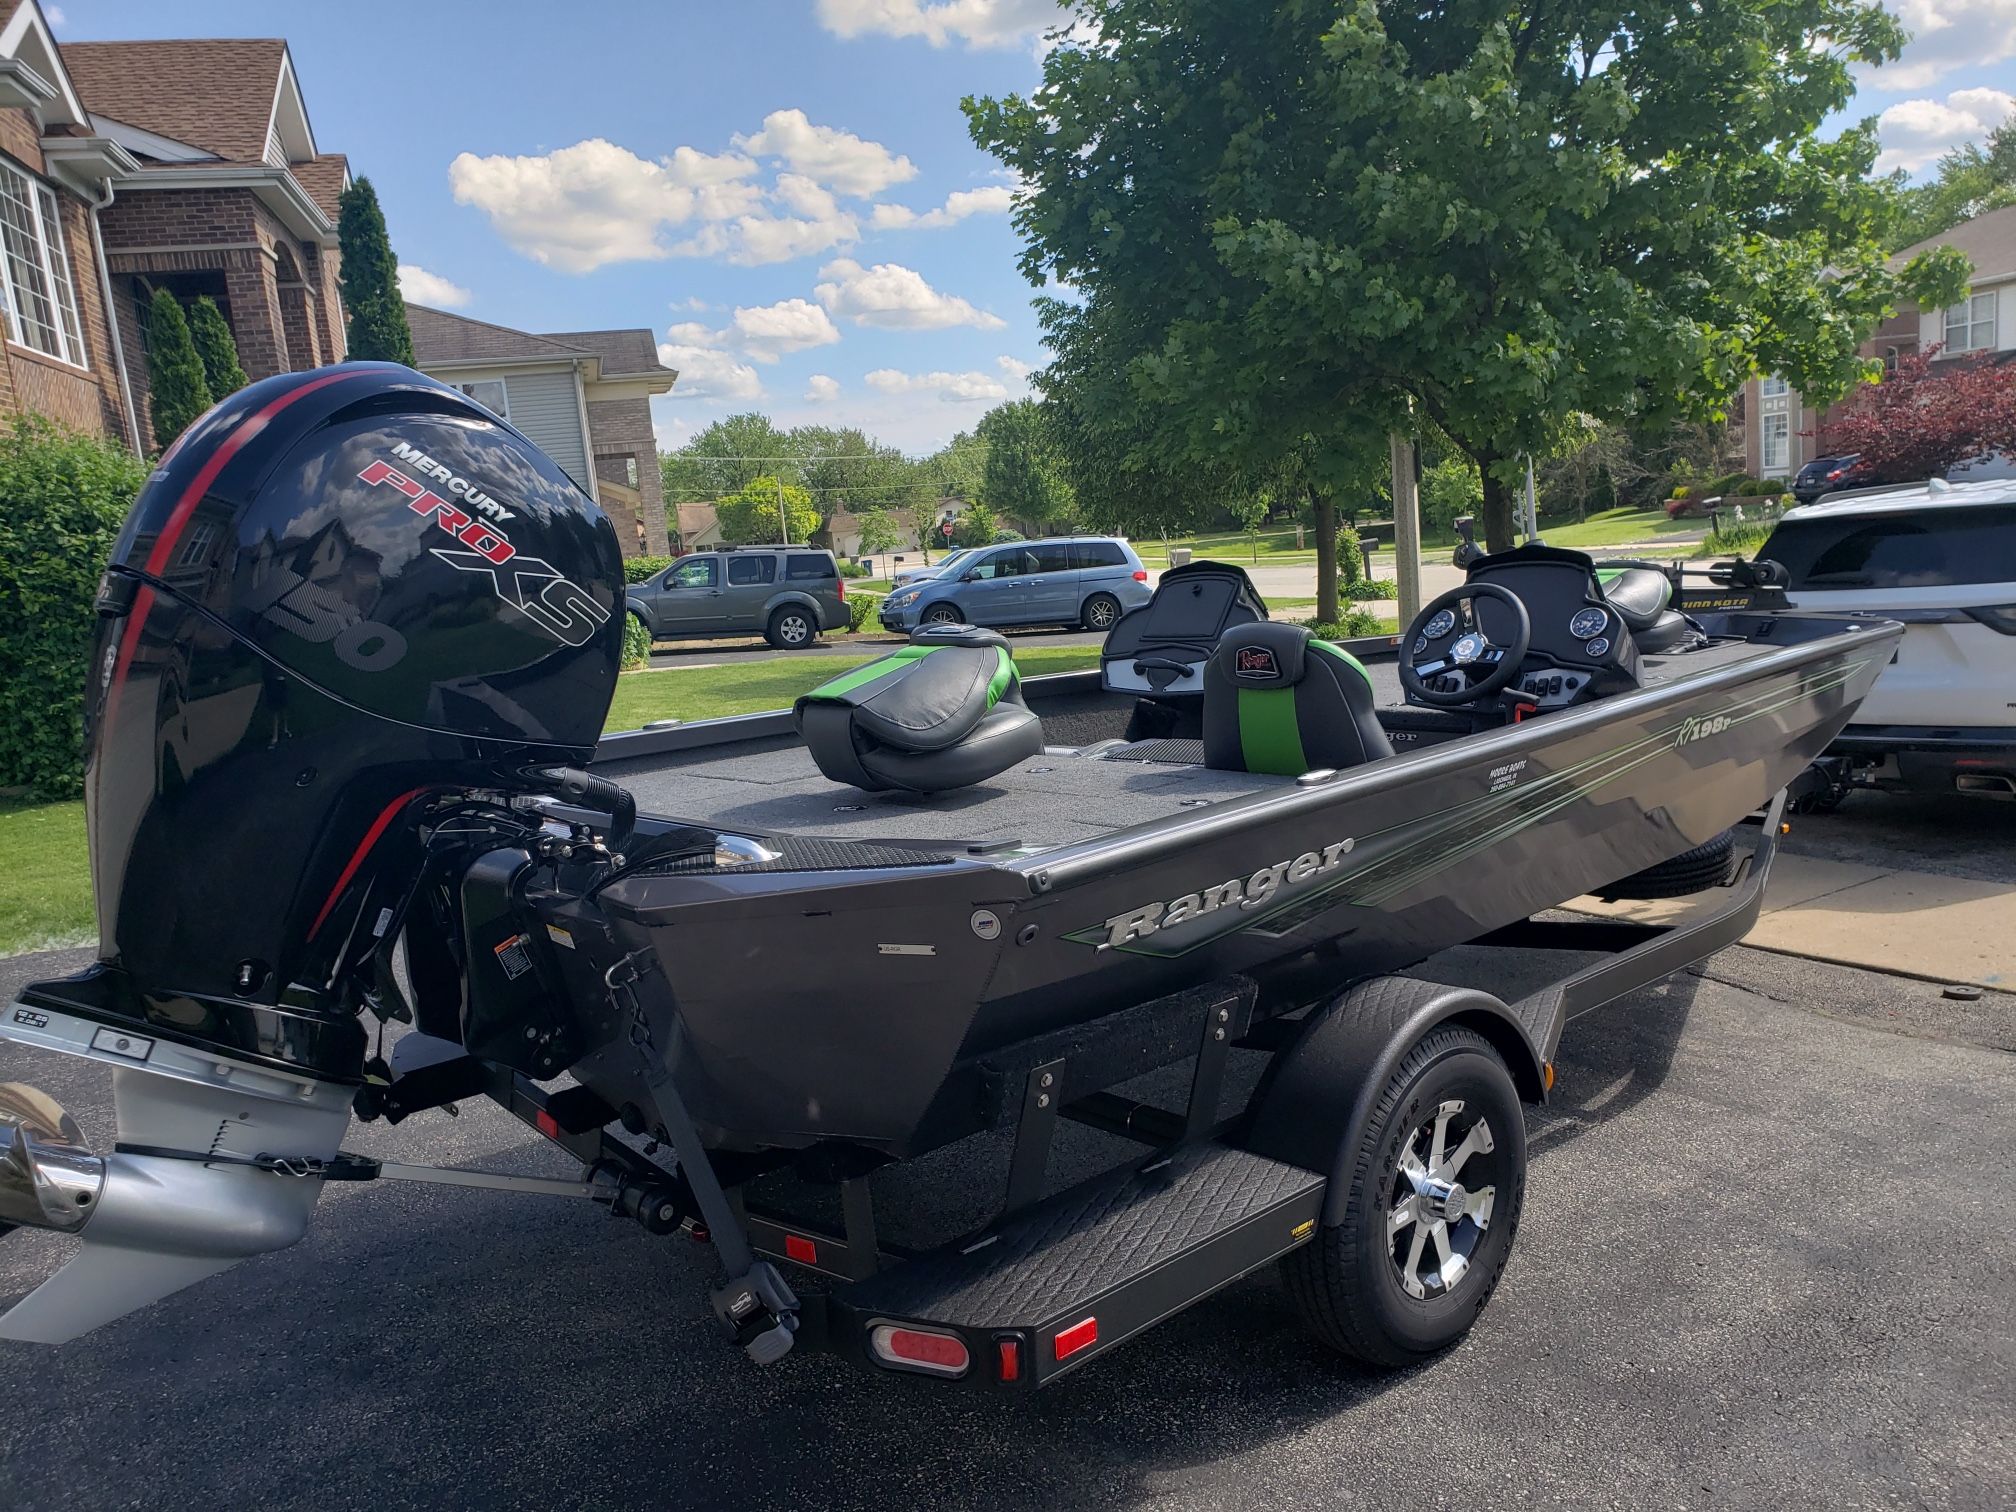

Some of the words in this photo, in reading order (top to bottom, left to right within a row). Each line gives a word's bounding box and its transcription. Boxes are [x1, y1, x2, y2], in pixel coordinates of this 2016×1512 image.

[357, 459, 516, 565] PRO
[391, 442, 516, 523] MERCURY
[429, 515, 612, 647] XS
[1713, 598, 1749, 607] KOTA
[1096, 837, 1355, 951] Ranger
